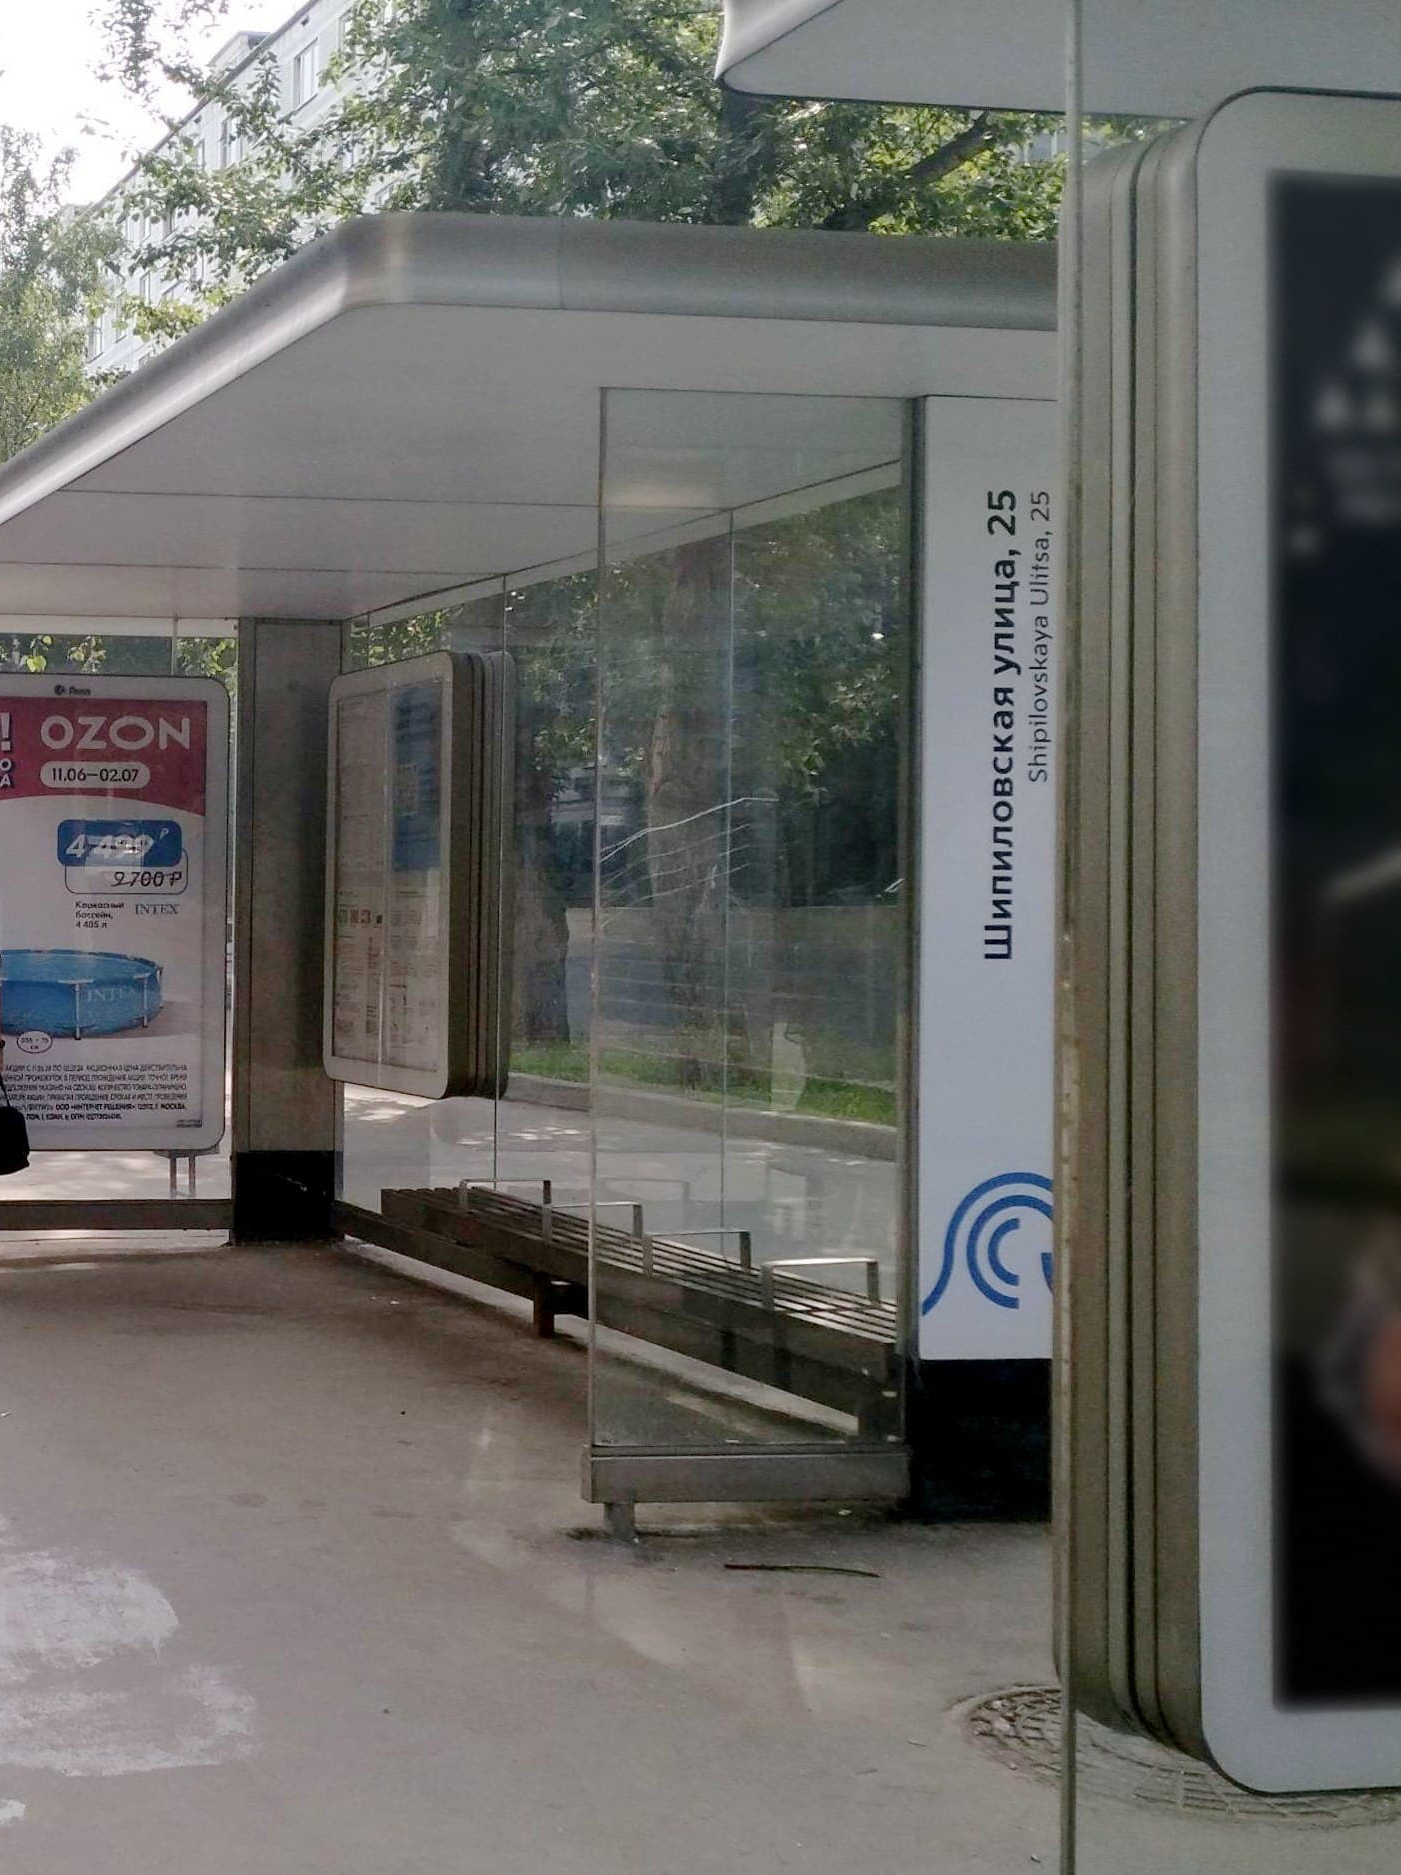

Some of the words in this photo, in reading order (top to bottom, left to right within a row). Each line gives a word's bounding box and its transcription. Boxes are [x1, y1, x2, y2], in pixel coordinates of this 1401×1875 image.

[987, 490, 1017, 537] 25
[1029, 491, 1050, 522] 25
[1029, 530, 1053, 606] Ulitsa,
[994, 547, 1022, 675] улица,
[1028, 616, 1053, 784] Shipilovskaya
[40, 714, 191, 751] OZON
[983, 685, 1015, 961] Шипиловская
[135, 903, 181, 916] INTEX
